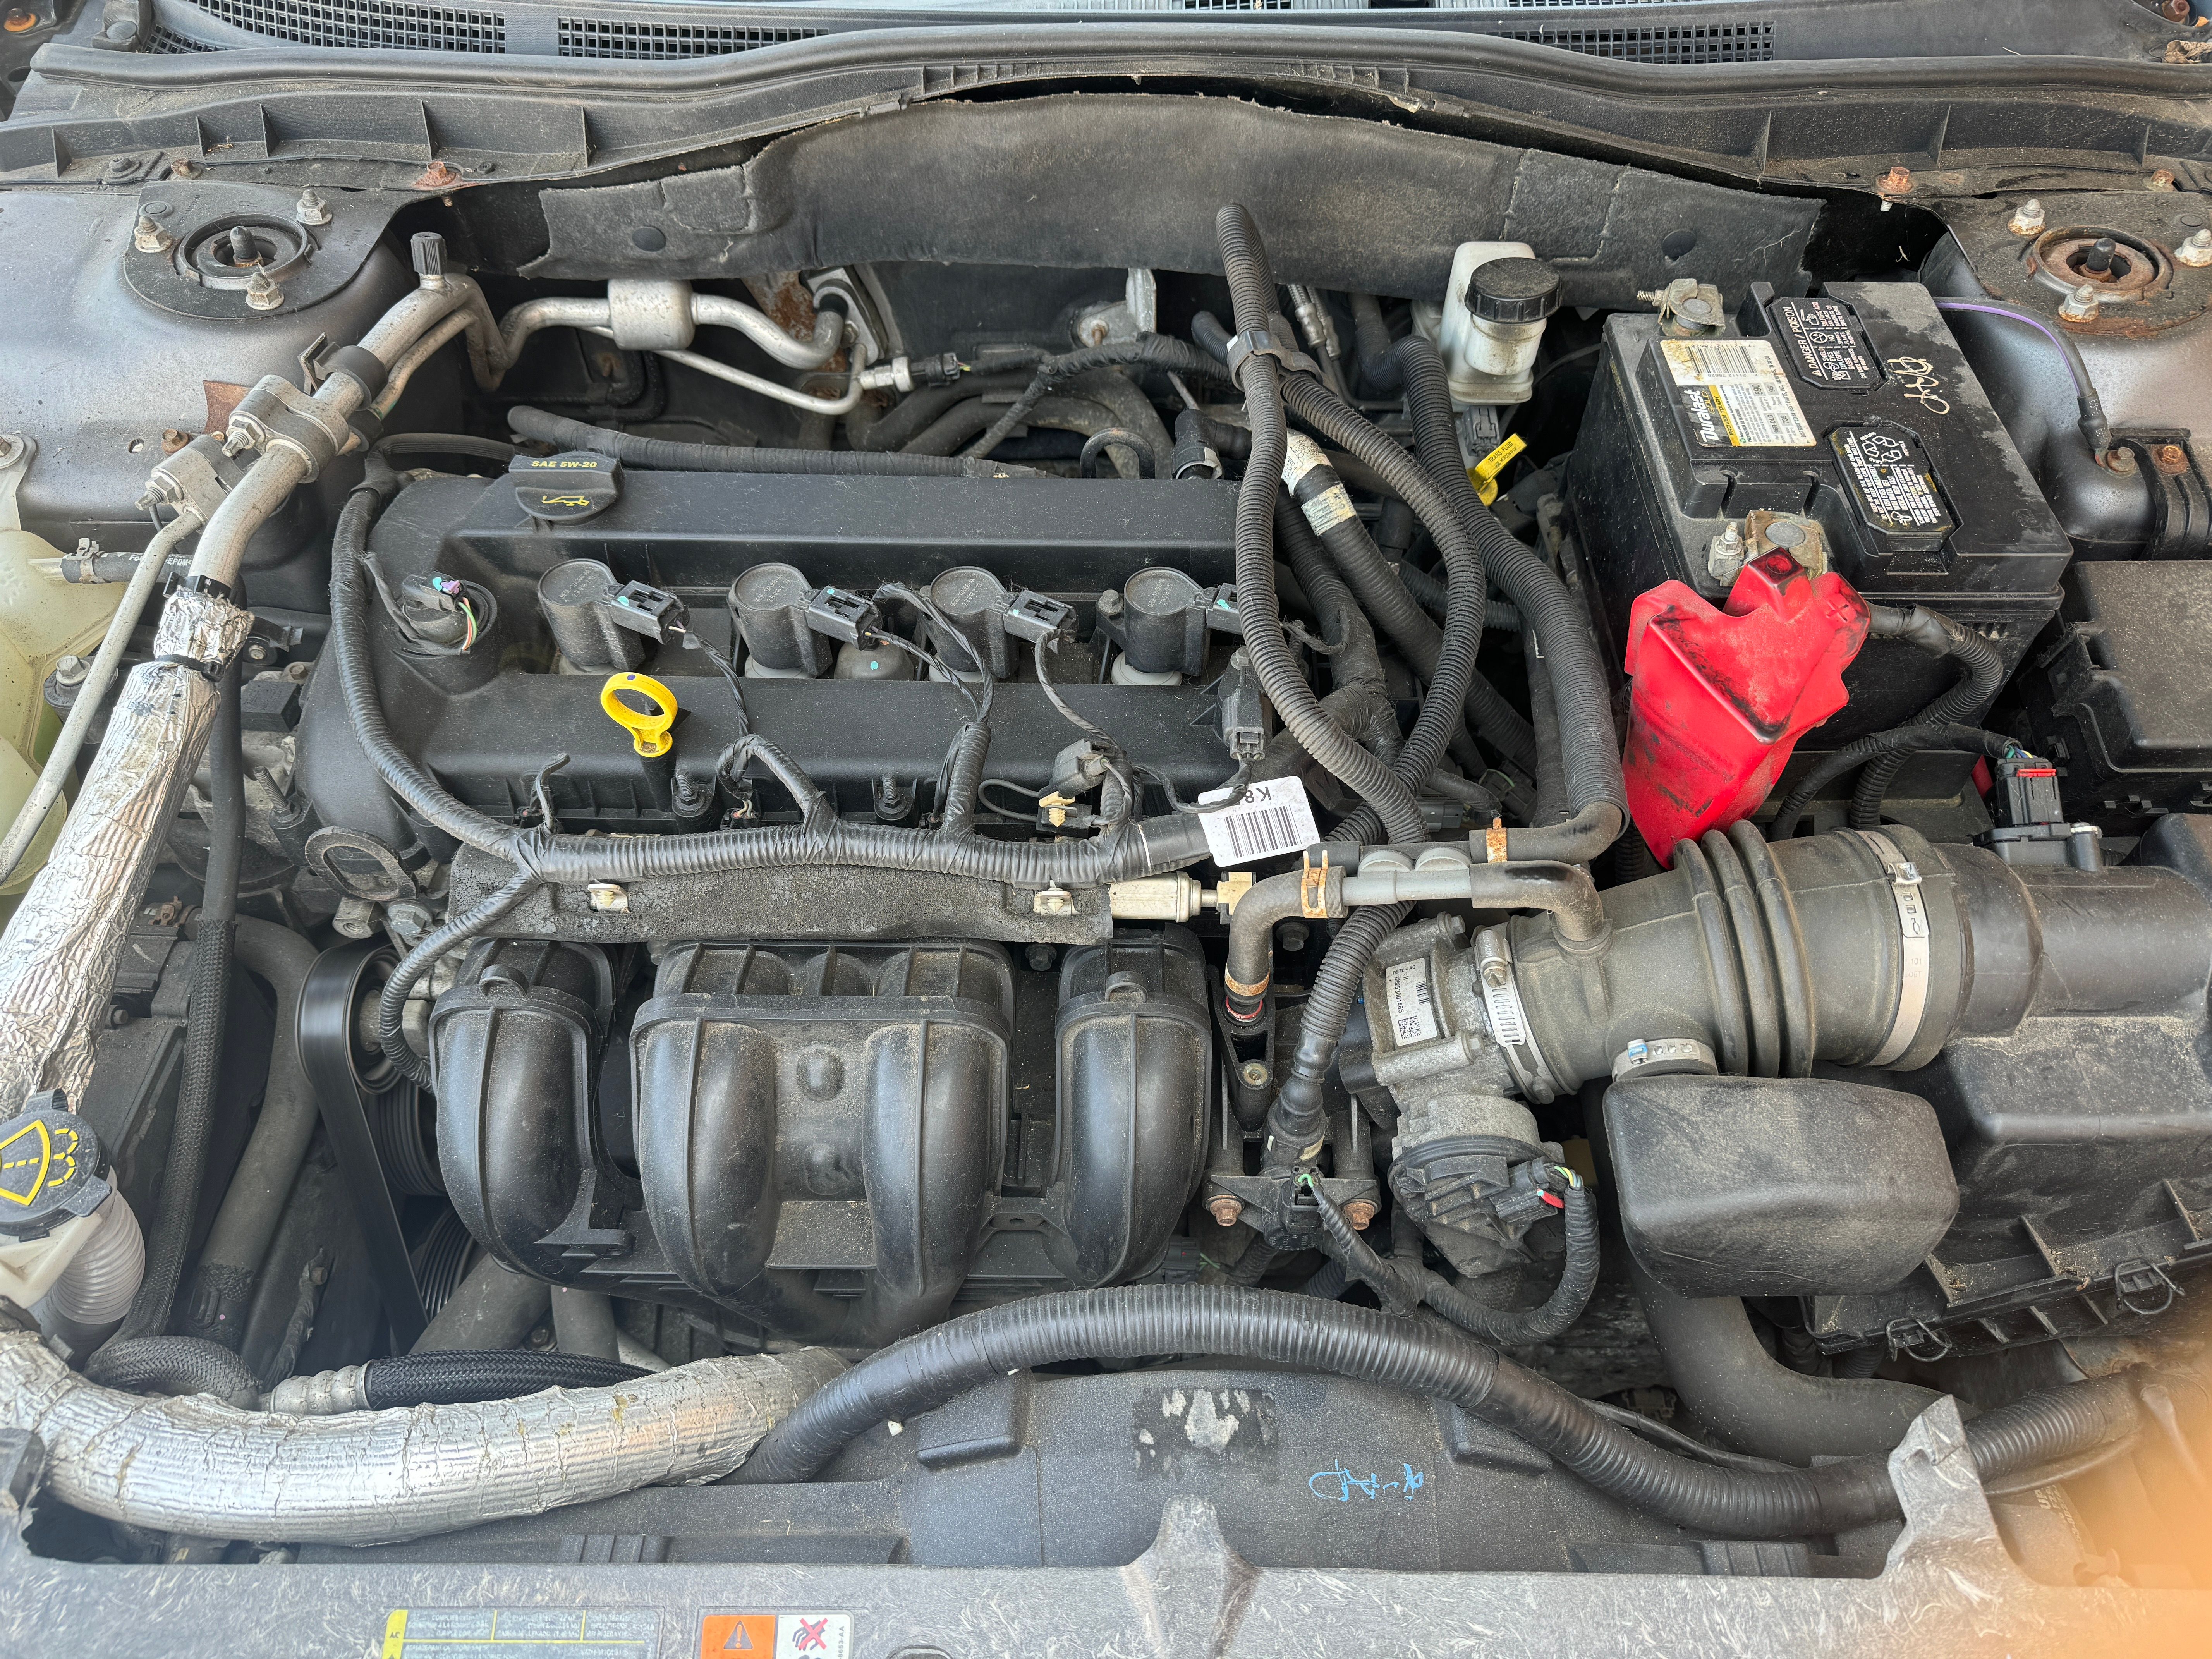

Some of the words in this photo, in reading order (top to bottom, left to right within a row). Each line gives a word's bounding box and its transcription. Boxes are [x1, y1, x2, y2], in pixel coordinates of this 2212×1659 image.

[1782, 307, 1802, 332] POISON
[1815, 310, 1829, 326] SULFURIC
[1797, 340, 1819, 368] DANGER
[1817, 348, 1829, 361] SHIELD
[1826, 352, 1836, 361] EYES
[1832, 350, 1848, 369] EXPLOSIVE
[1844, 357, 1855, 369] GASES
[1751, 384, 1764, 394] 590
[1700, 390, 1716, 414] GOLD
[1714, 396, 1725, 412] TOUGH
[1683, 389, 1720, 441] Duralast
[1767, 414, 1780, 432] 96R-DLG
[1780, 415, 1790, 423] 735
[1722, 415, 1734, 434] PROVEN
[1488, 450, 1502, 463] TRANS
[1501, 441, 1513, 452] FLUID
[1878, 489, 1888, 498] EYES
